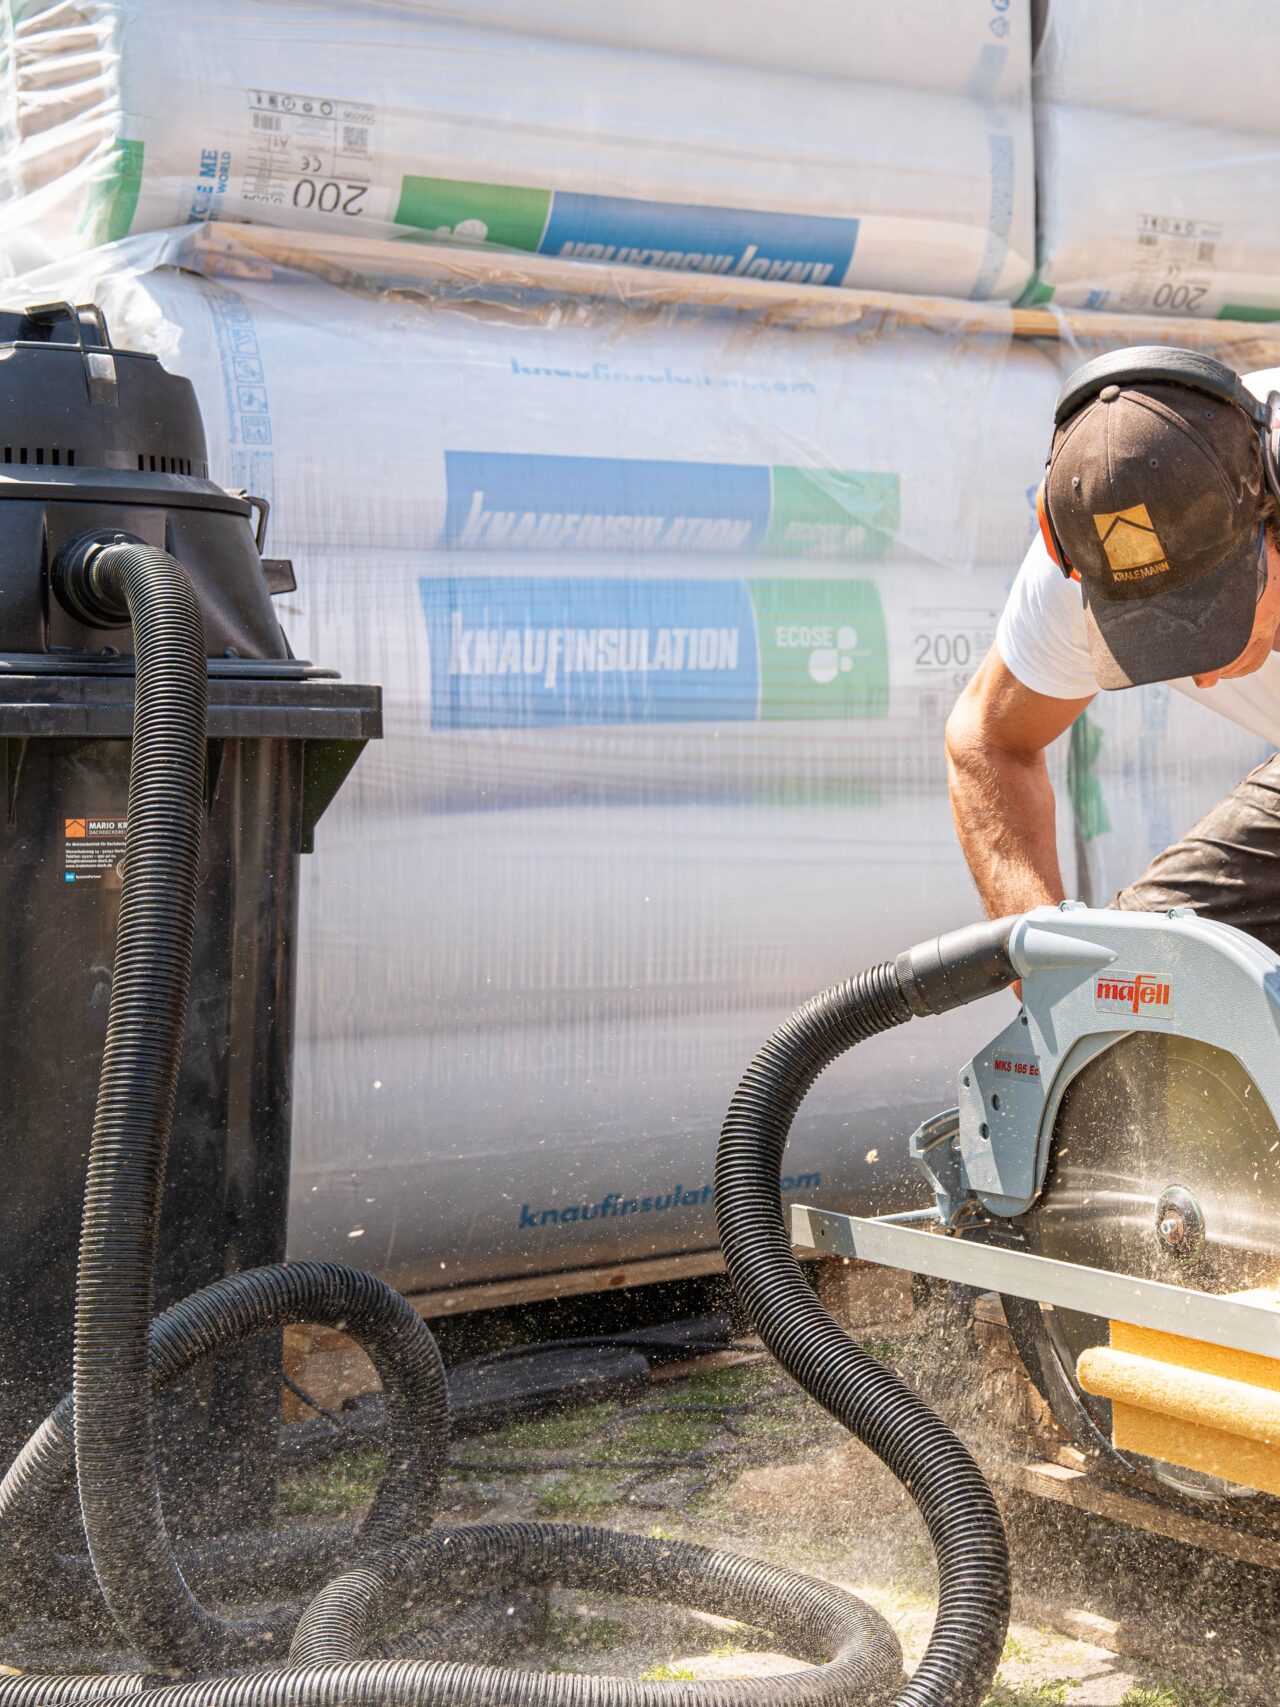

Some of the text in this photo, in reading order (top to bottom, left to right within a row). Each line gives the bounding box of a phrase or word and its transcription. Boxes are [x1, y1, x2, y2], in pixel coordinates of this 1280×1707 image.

[199, 149, 218, 178] ME
[216, 151, 232, 194] WORLD
[293, 179, 369, 216] 200
[1153, 283, 1208, 311] 200
[1112, 561, 1170, 582] KRALEMANN
[775, 626, 834, 647] ECOSE
[914, 634, 971, 666] 200
[1097, 975, 1170, 1013] mafell
[994, 1060, 1012, 1072] MKS
[1014, 1063, 1027, 1075] 185
[518, 1171, 822, 1229] knaufinsulatom
